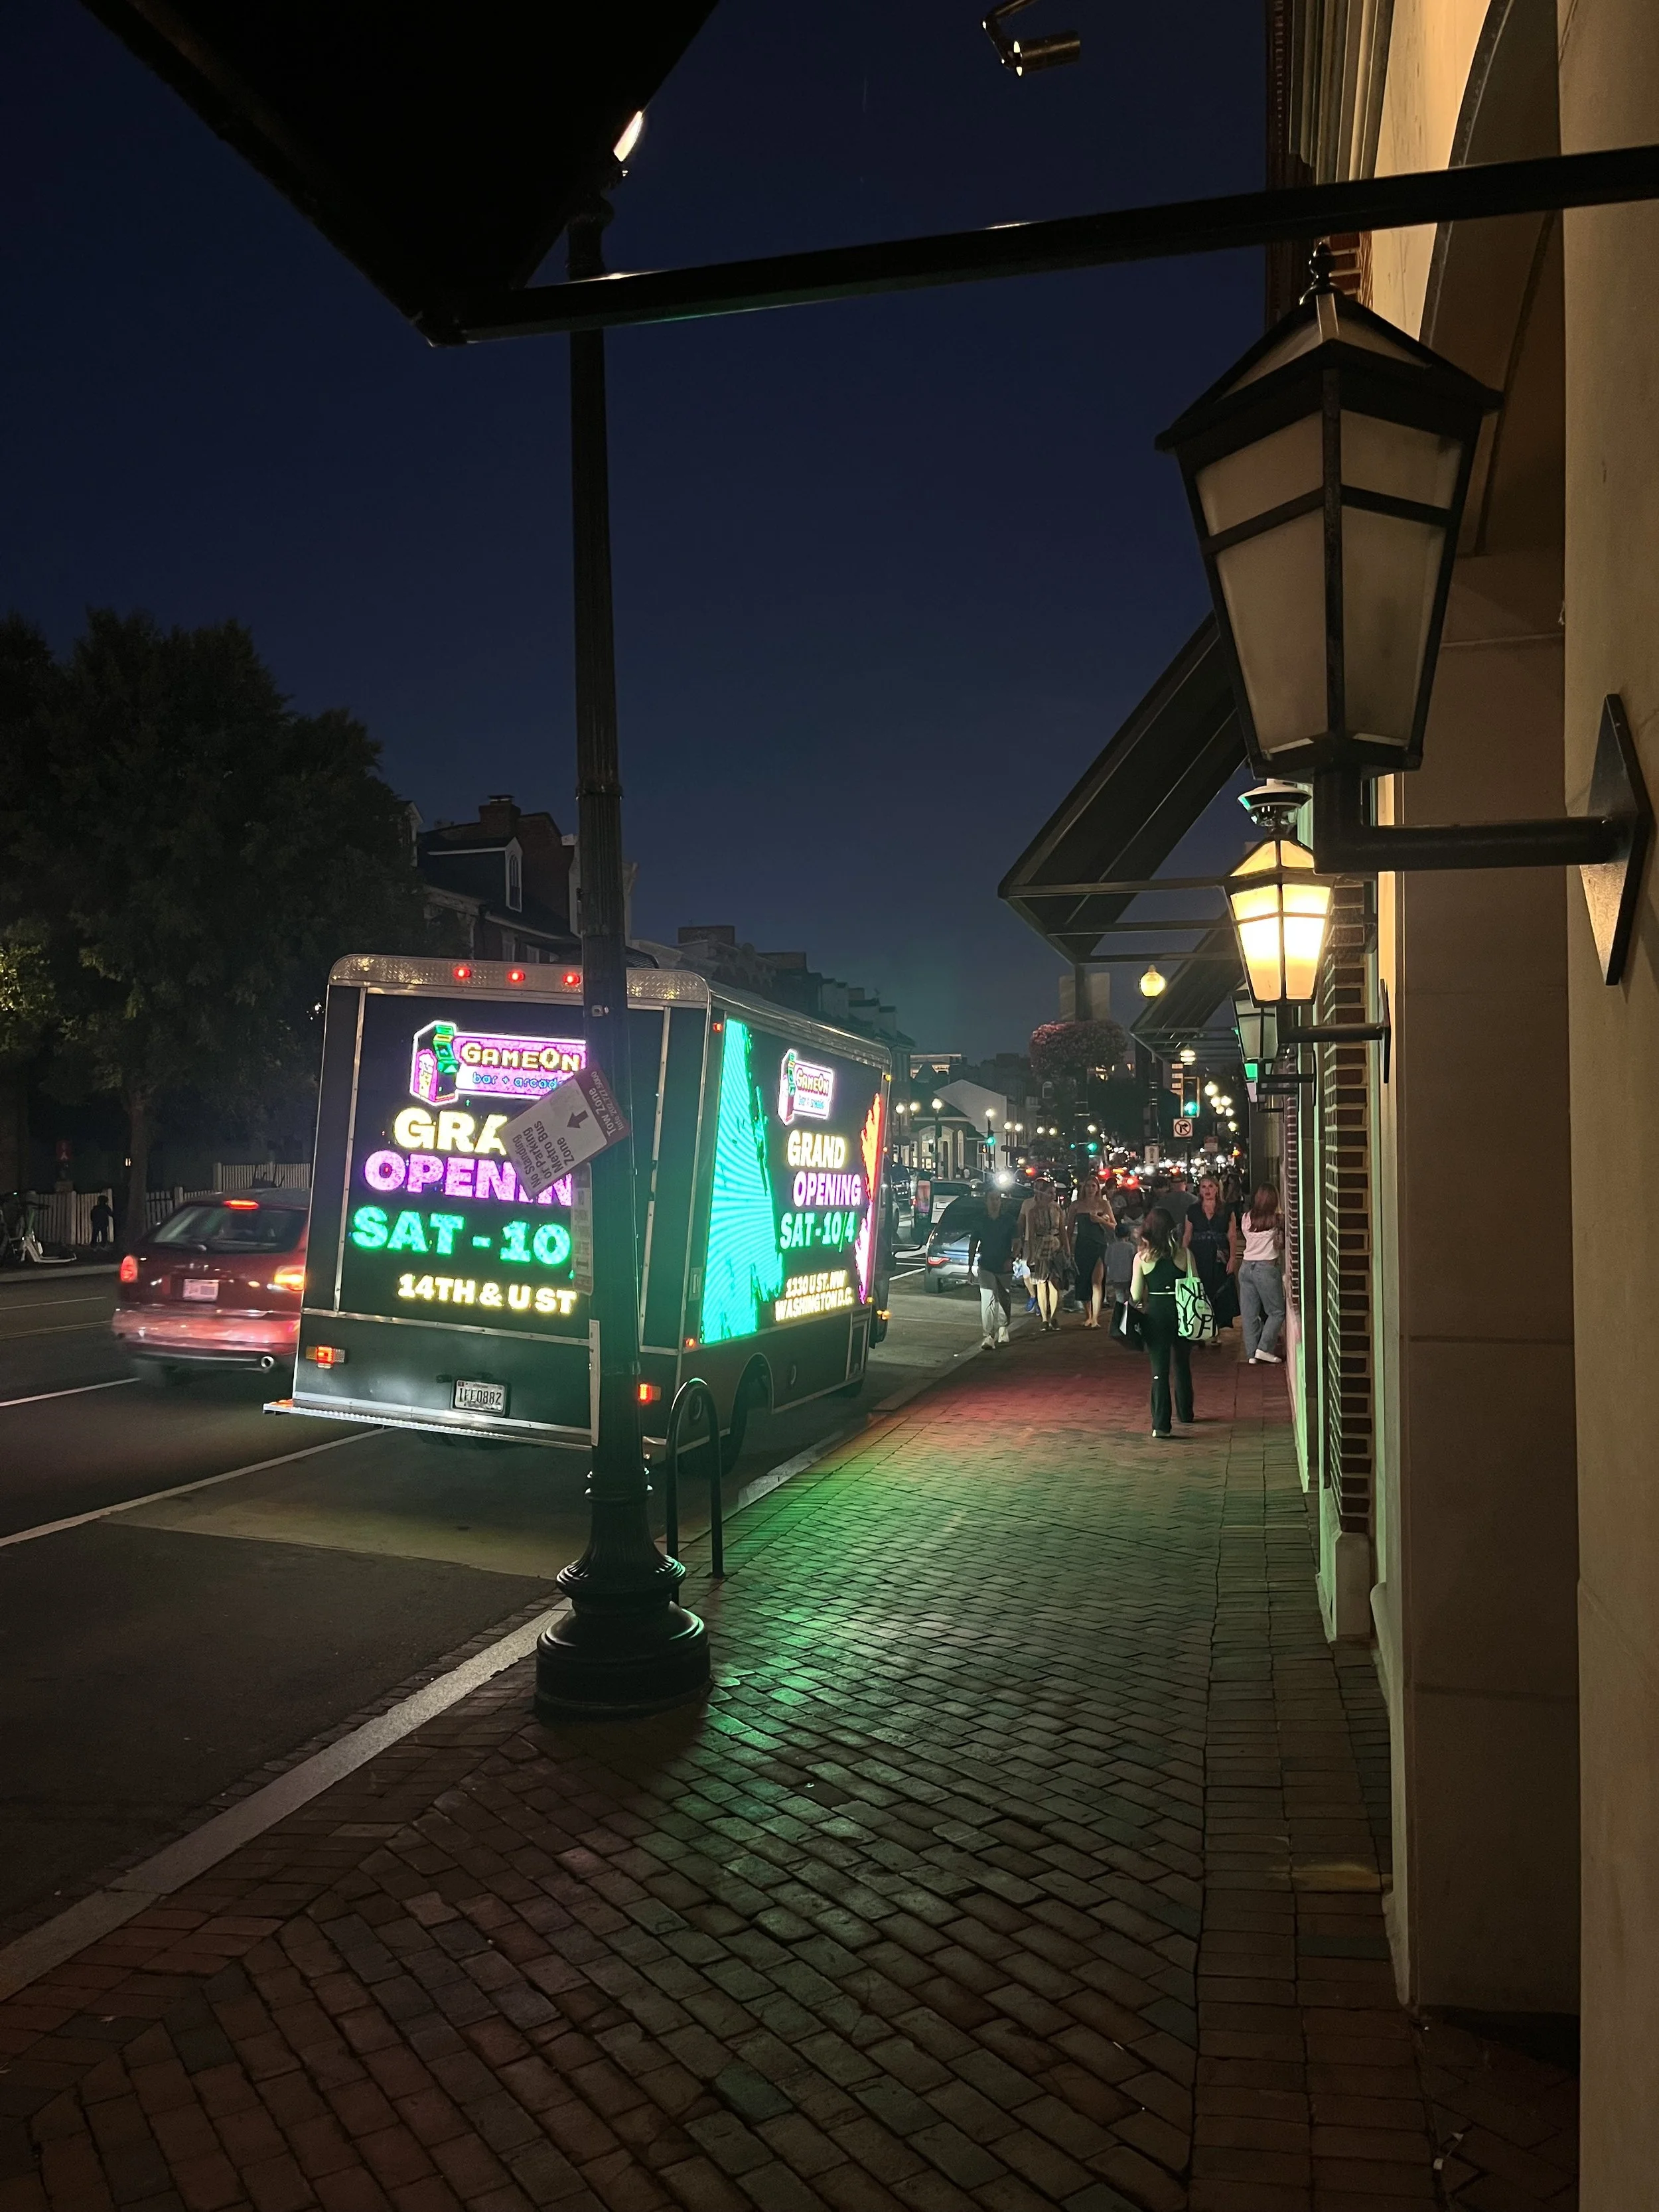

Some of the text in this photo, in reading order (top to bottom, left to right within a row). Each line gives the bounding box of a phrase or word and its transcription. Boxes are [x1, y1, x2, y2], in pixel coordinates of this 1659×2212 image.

[472, 1072, 496, 1084] bar
[589, 1088, 616, 1137] Tow Zone
[614, 1115, 624, 1131] Info
[512, 1134, 541, 1189] No Standing
[523, 1127, 552, 1179] or Parking
[534, 1120, 563, 1174] Metro Bus
[557, 1137, 575, 1165] Zone
[787, 1130, 845, 1169] GRAND
[793, 1171, 861, 1207] OPENING
[352, 1205, 465, 1255] SAT
[500, 1220, 572, 1266] 10
[398, 1274, 577, 1315] 14TH & U ST
[809, 1274, 816, 1294] U
